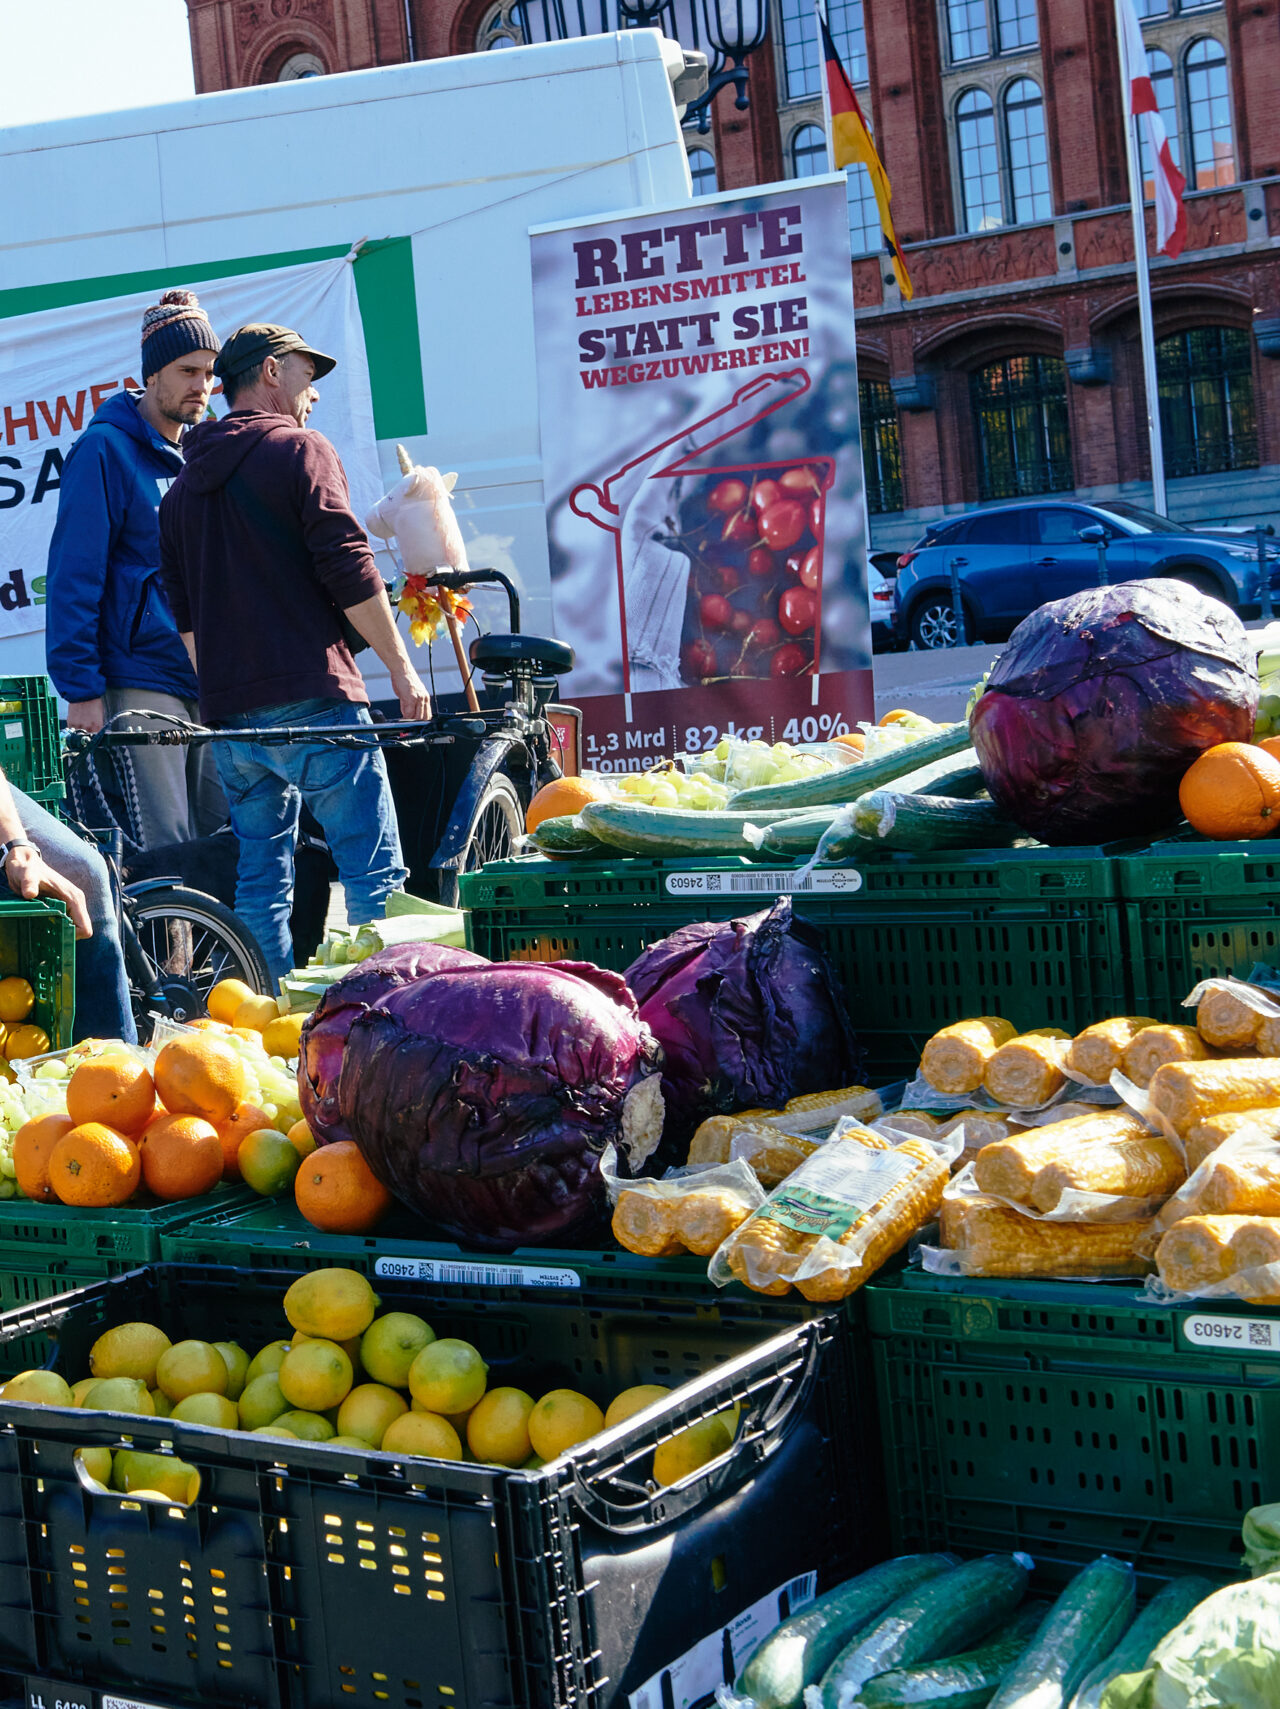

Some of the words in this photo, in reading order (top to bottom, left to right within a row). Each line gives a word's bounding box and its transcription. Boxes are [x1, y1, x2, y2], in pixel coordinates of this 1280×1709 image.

[573, 205, 803, 289] RETTE
[575, 262, 807, 317] LEBENSMITTEL
[578, 312, 720, 363] STATT
[733, 297, 808, 340] SIE
[580, 337, 810, 390] WEGZUWERFEN!
[587, 733, 620, 756] 1,3
[625, 727, 666, 750] Mrd
[685, 725, 719, 752] 82
[782, 713, 850, 744] 40%
[671, 877, 703, 889] 24603
[382, 1262, 415, 1277] 24603
[1194, 1322, 1242, 1339] 24603
